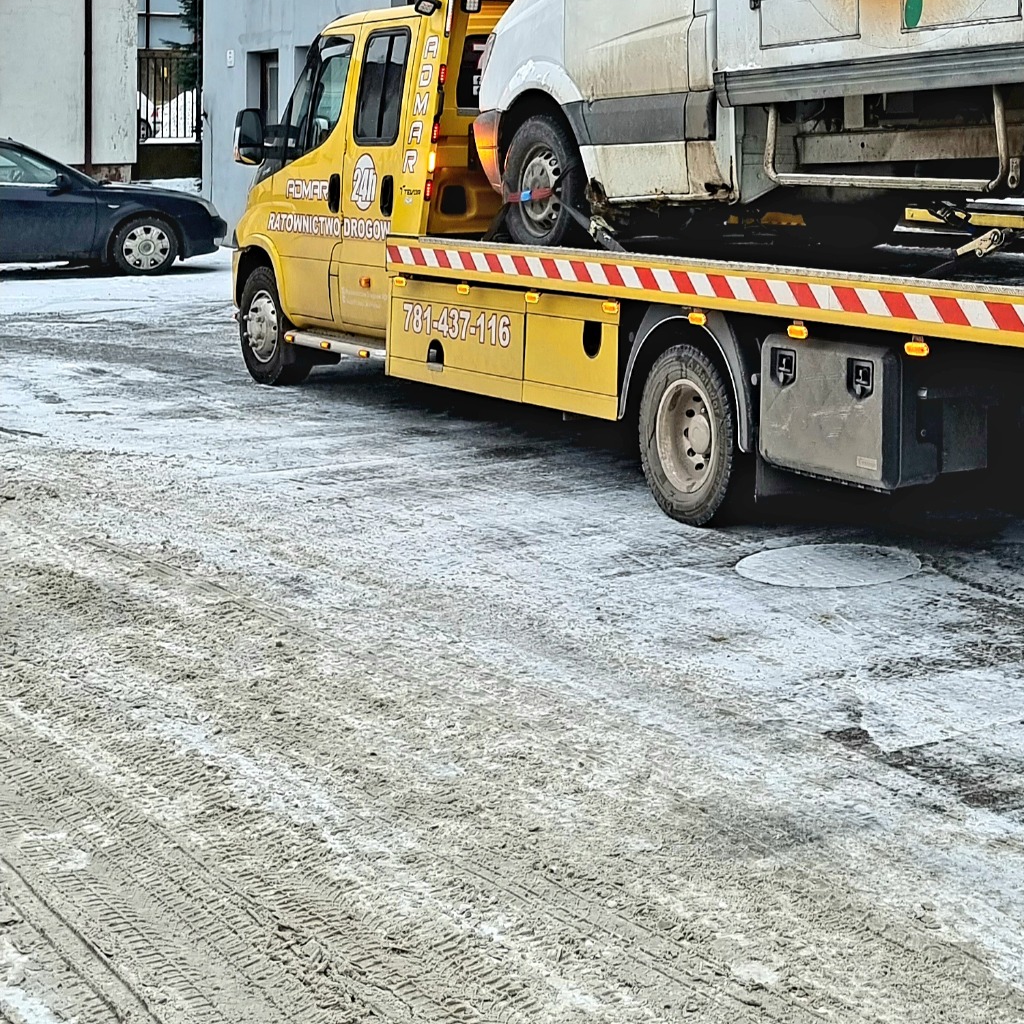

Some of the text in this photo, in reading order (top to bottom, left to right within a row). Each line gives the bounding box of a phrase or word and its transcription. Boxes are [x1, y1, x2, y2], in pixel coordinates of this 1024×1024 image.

[402, 35, 440, 174] ADMAR
[351, 167, 378, 203] 24h
[267, 211, 341, 237] RATOWNICTWO
[402, 301, 512, 348] 781-437-116
